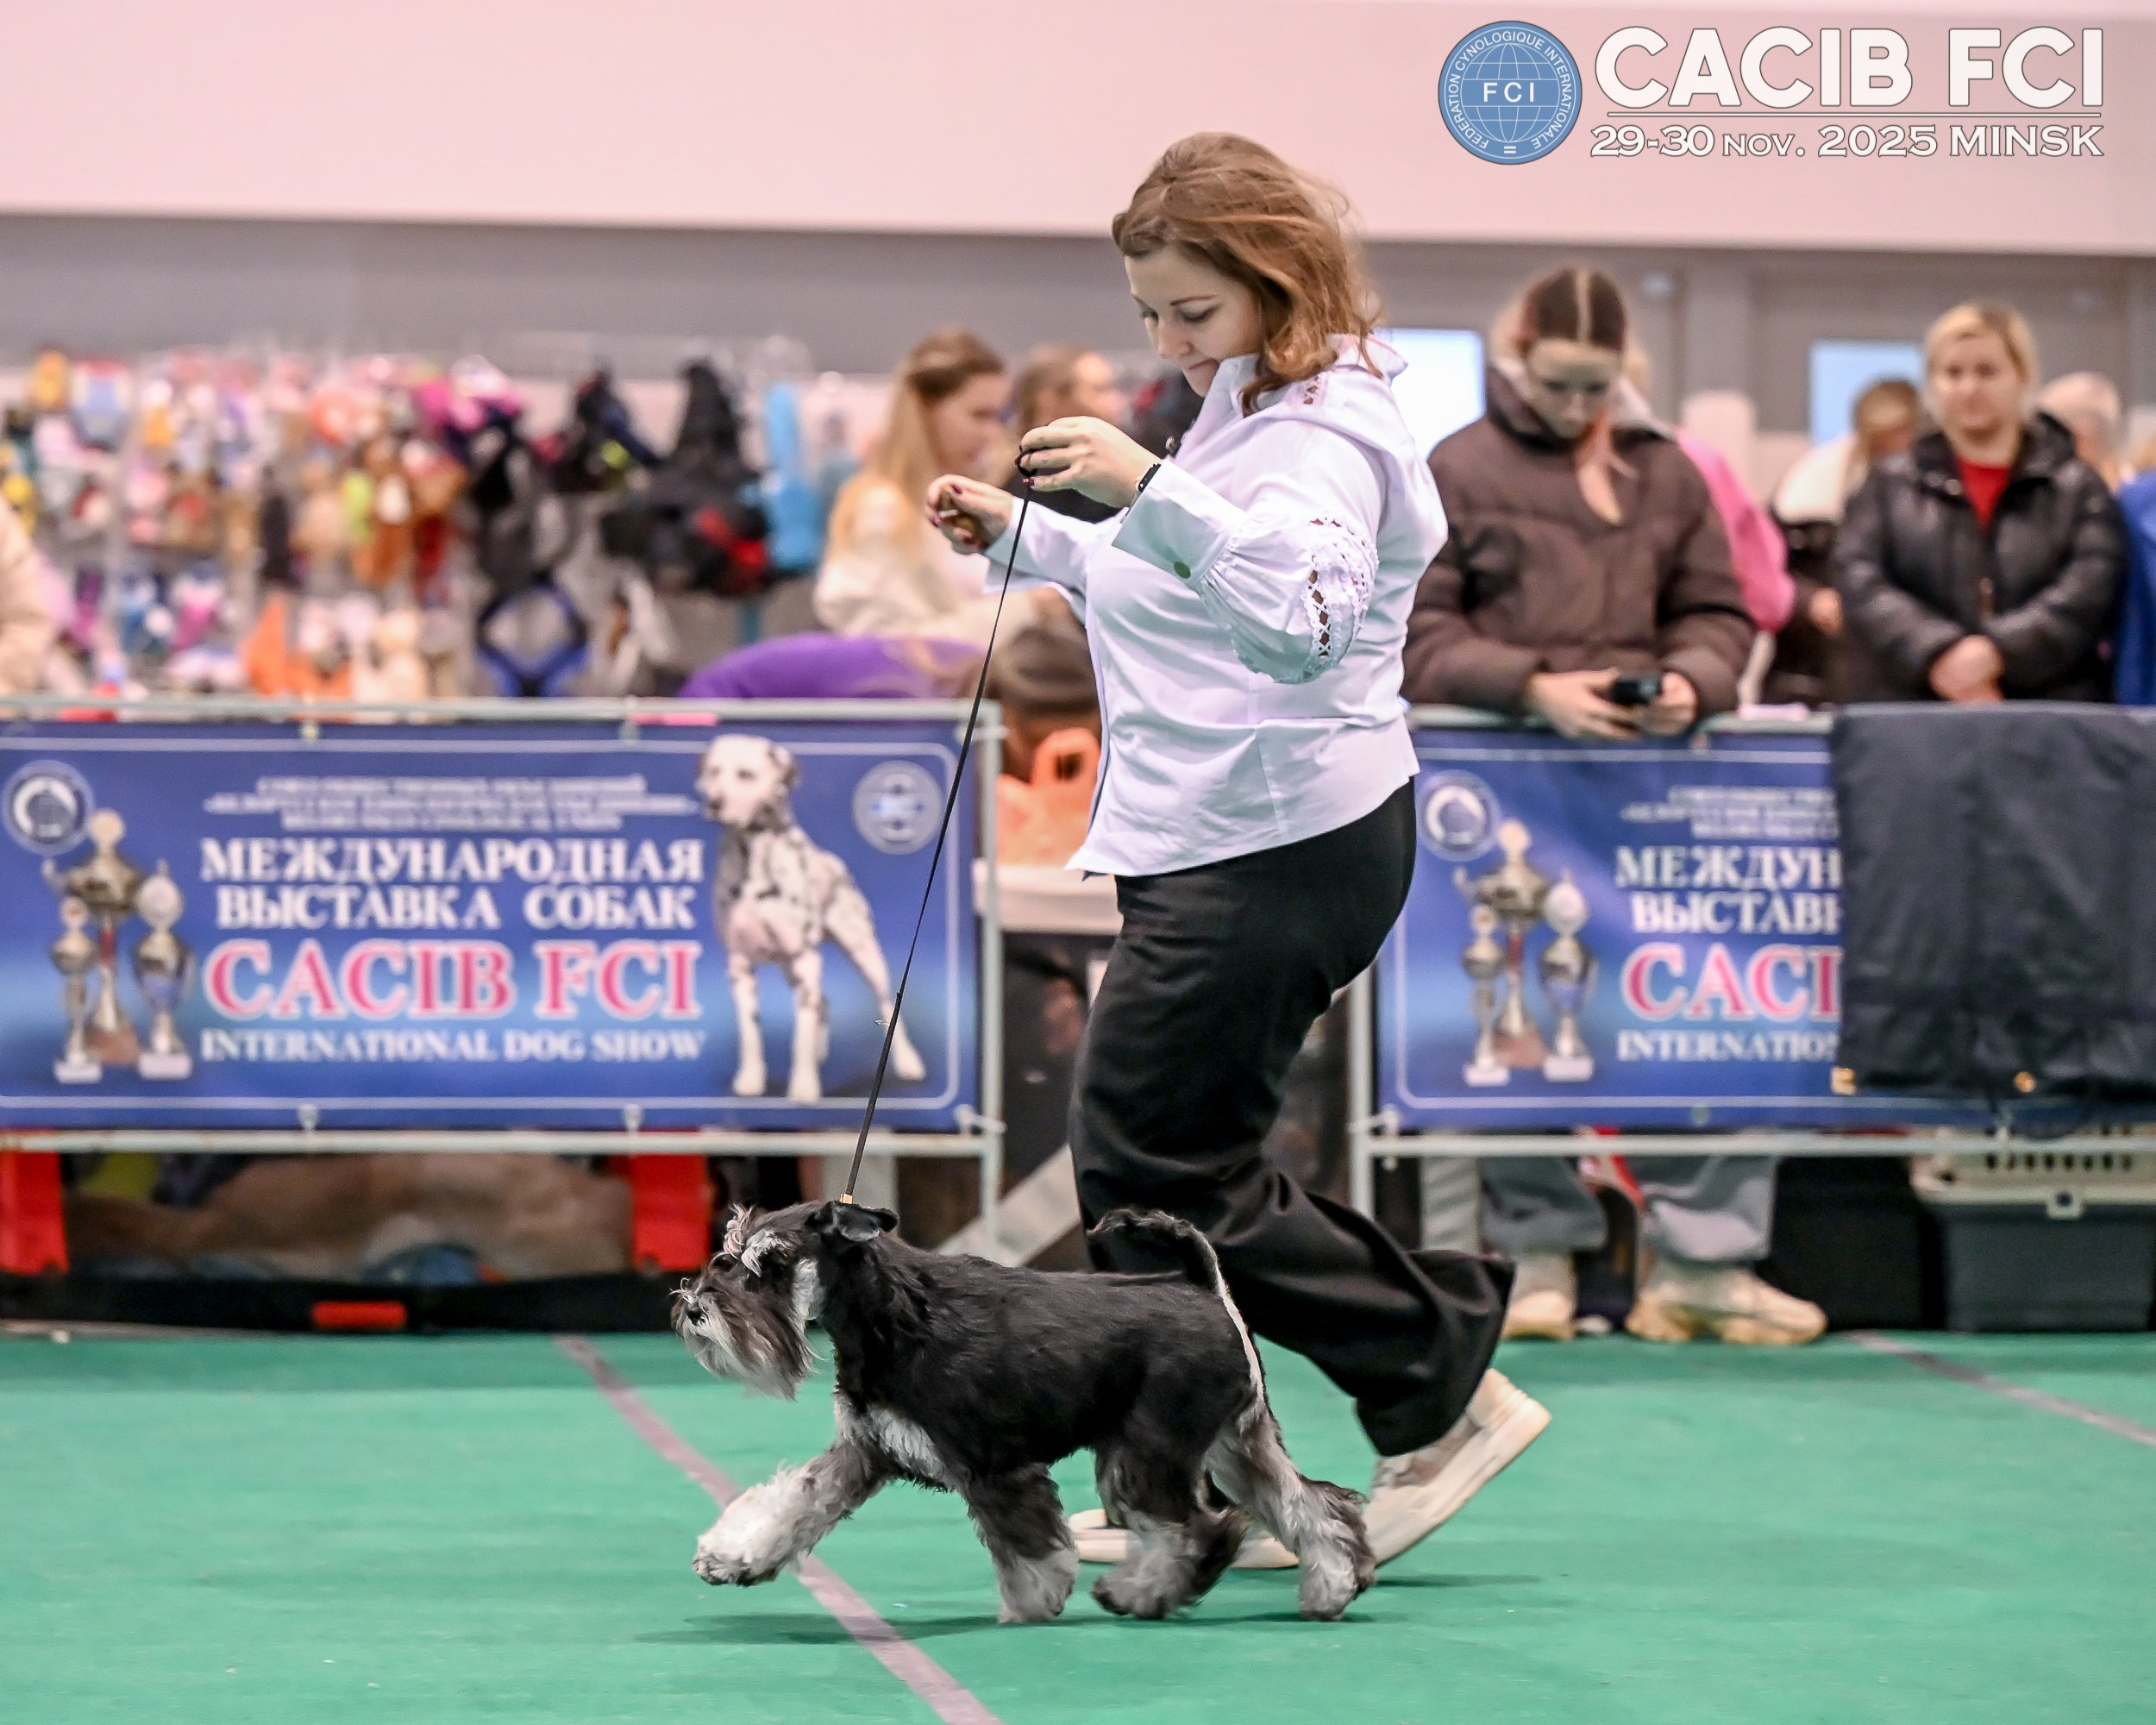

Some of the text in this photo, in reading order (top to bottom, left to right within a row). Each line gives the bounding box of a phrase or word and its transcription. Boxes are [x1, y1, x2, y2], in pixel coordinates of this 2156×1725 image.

[199, 837, 705, 885] МЕЖДУНАРОДНАЯ
[216, 885, 696, 930] ВЫСТАВКА СОБАК
[204, 938, 703, 1021] CACIB FCI
[199, 1029, 705, 1063] INTERNATIONAL DOG SHOW
